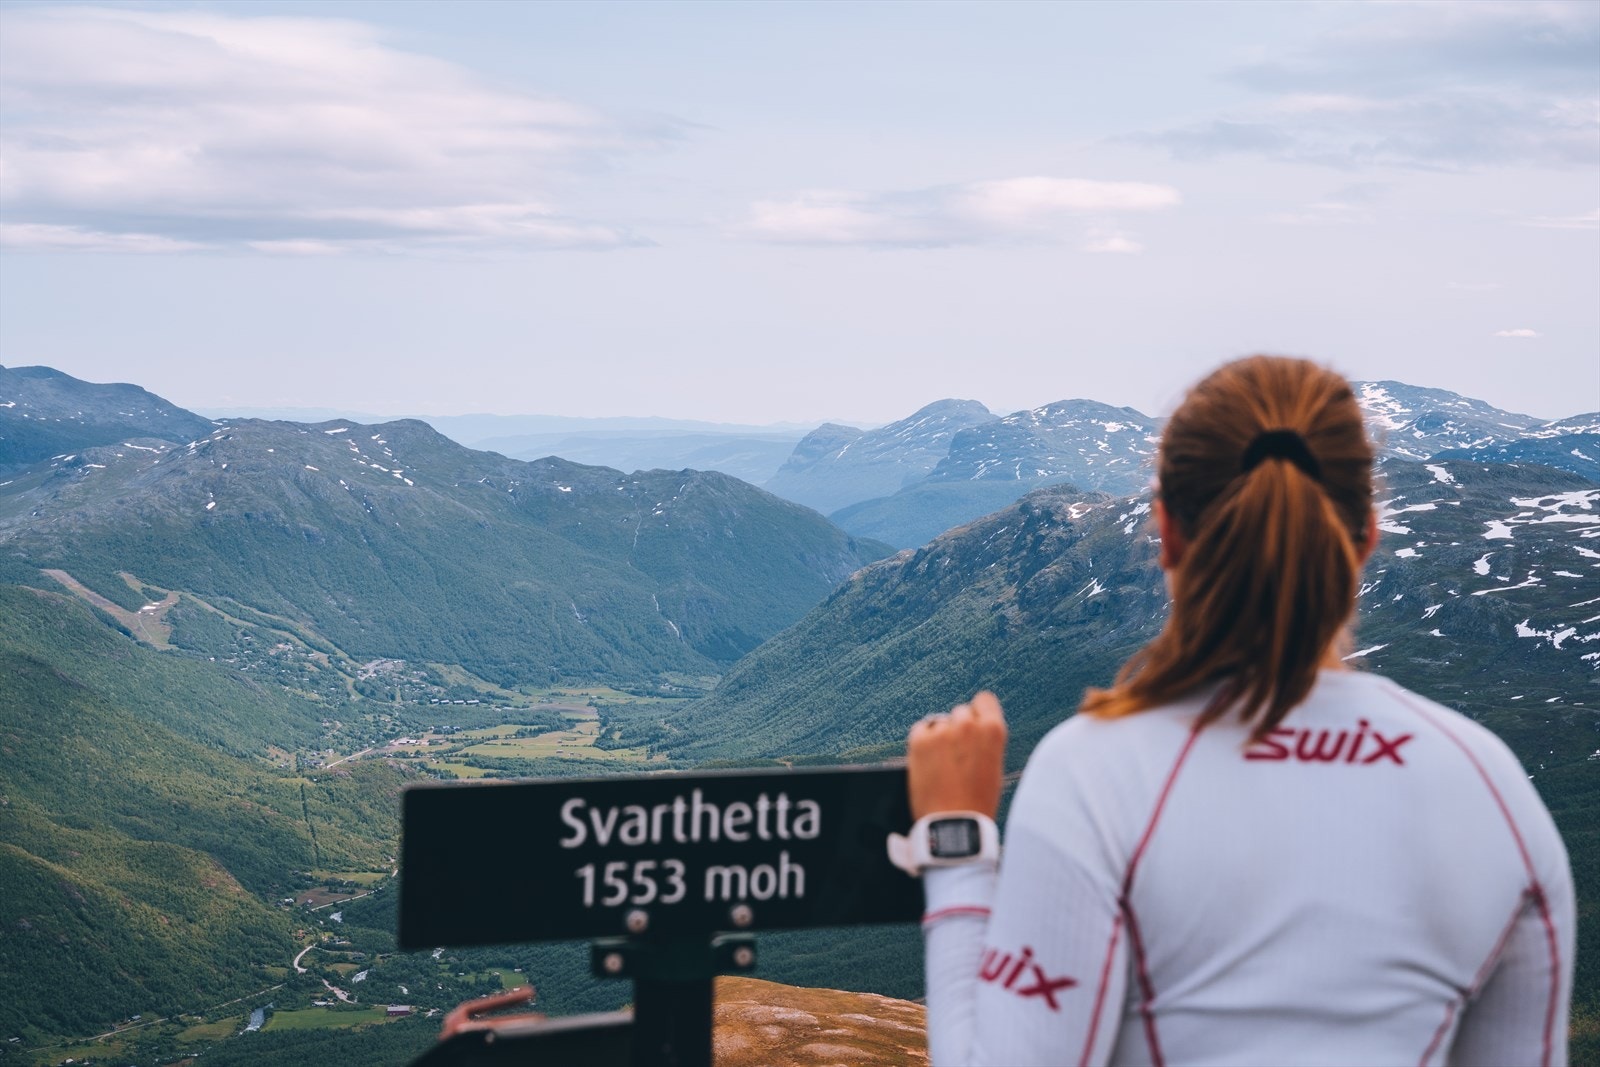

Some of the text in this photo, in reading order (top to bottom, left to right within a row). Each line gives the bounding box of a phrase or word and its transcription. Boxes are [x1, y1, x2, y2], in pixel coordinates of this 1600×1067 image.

[1243, 719, 1414, 766] swix
[560, 788, 821, 849] Svarthetta
[576, 850, 805, 907] 1553 moh
